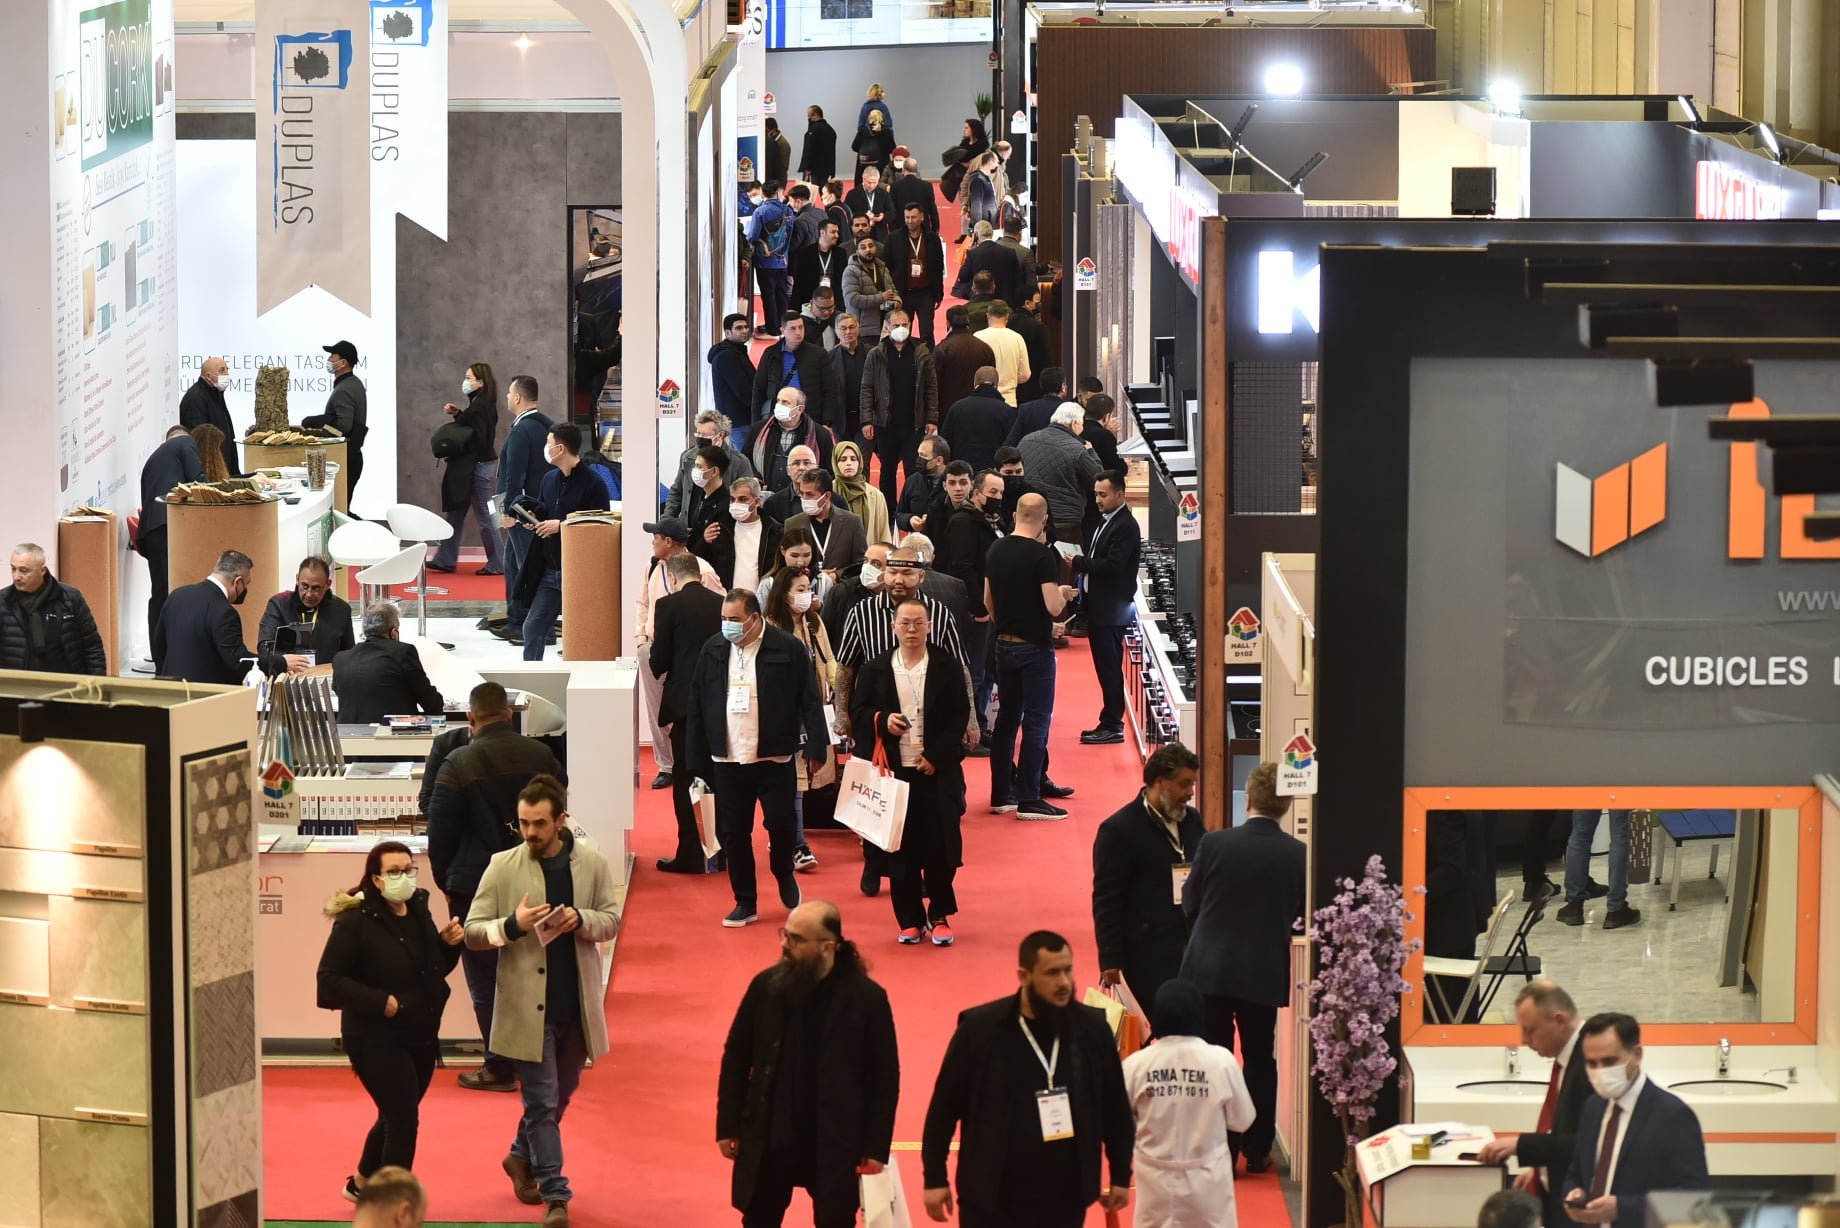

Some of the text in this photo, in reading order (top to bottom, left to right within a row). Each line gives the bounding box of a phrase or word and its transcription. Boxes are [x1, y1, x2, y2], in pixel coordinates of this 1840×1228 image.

[371, 52, 399, 162] DUPLAS
[281, 96, 314, 224] DUPLAS
[294, 354, 368, 370] TASM
[1645, 656, 1809, 686] CUBICLES
[1283, 771, 1304, 779] HALL
[264, 801, 287, 809] HALL
[1181, 1068, 1209, 1084] TEM.
[1185, 1086, 1196, 1097] 10
[1198, 1087, 1209, 1098] 11
